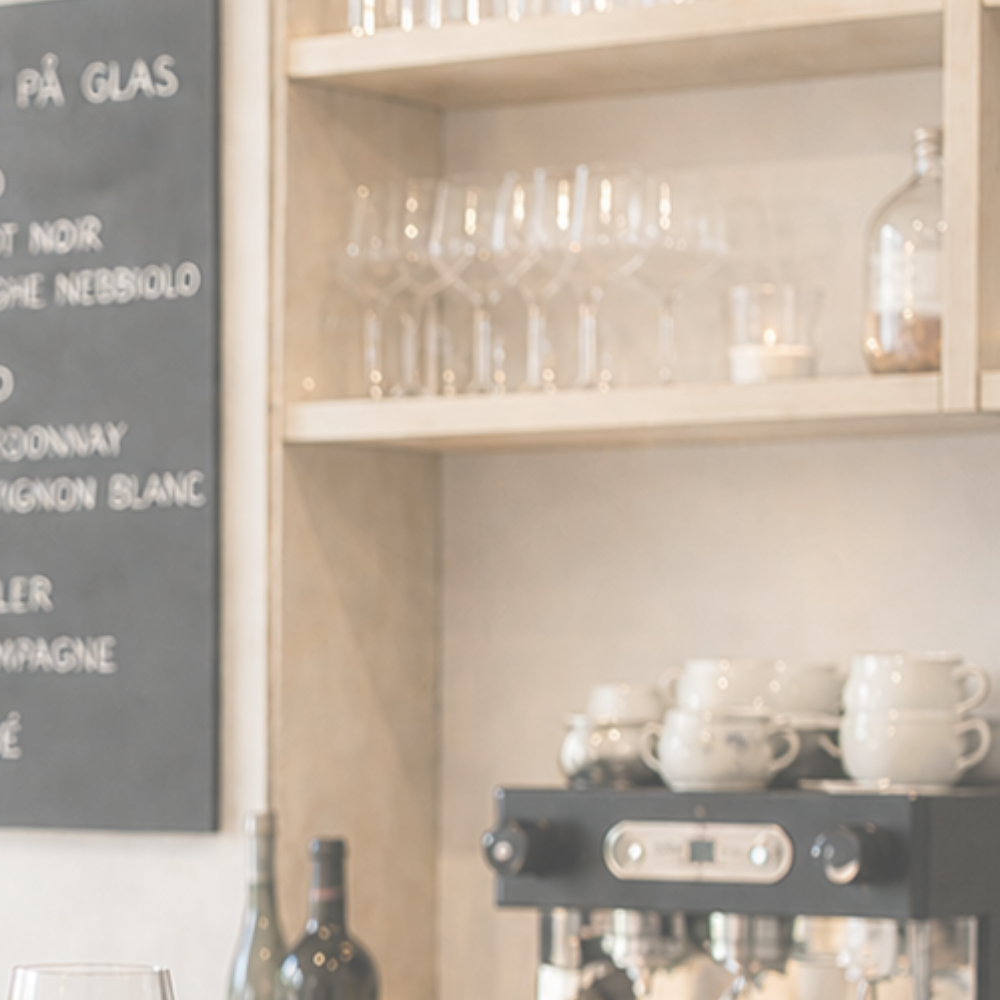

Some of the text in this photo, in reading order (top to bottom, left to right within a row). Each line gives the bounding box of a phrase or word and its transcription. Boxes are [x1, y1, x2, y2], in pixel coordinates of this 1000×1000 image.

[16, 53, 65, 109] PÅ
[80, 54, 179, 104] GLAS
[28, 215, 103, 256] NOIR
[108, 470, 206, 511] BLANC
